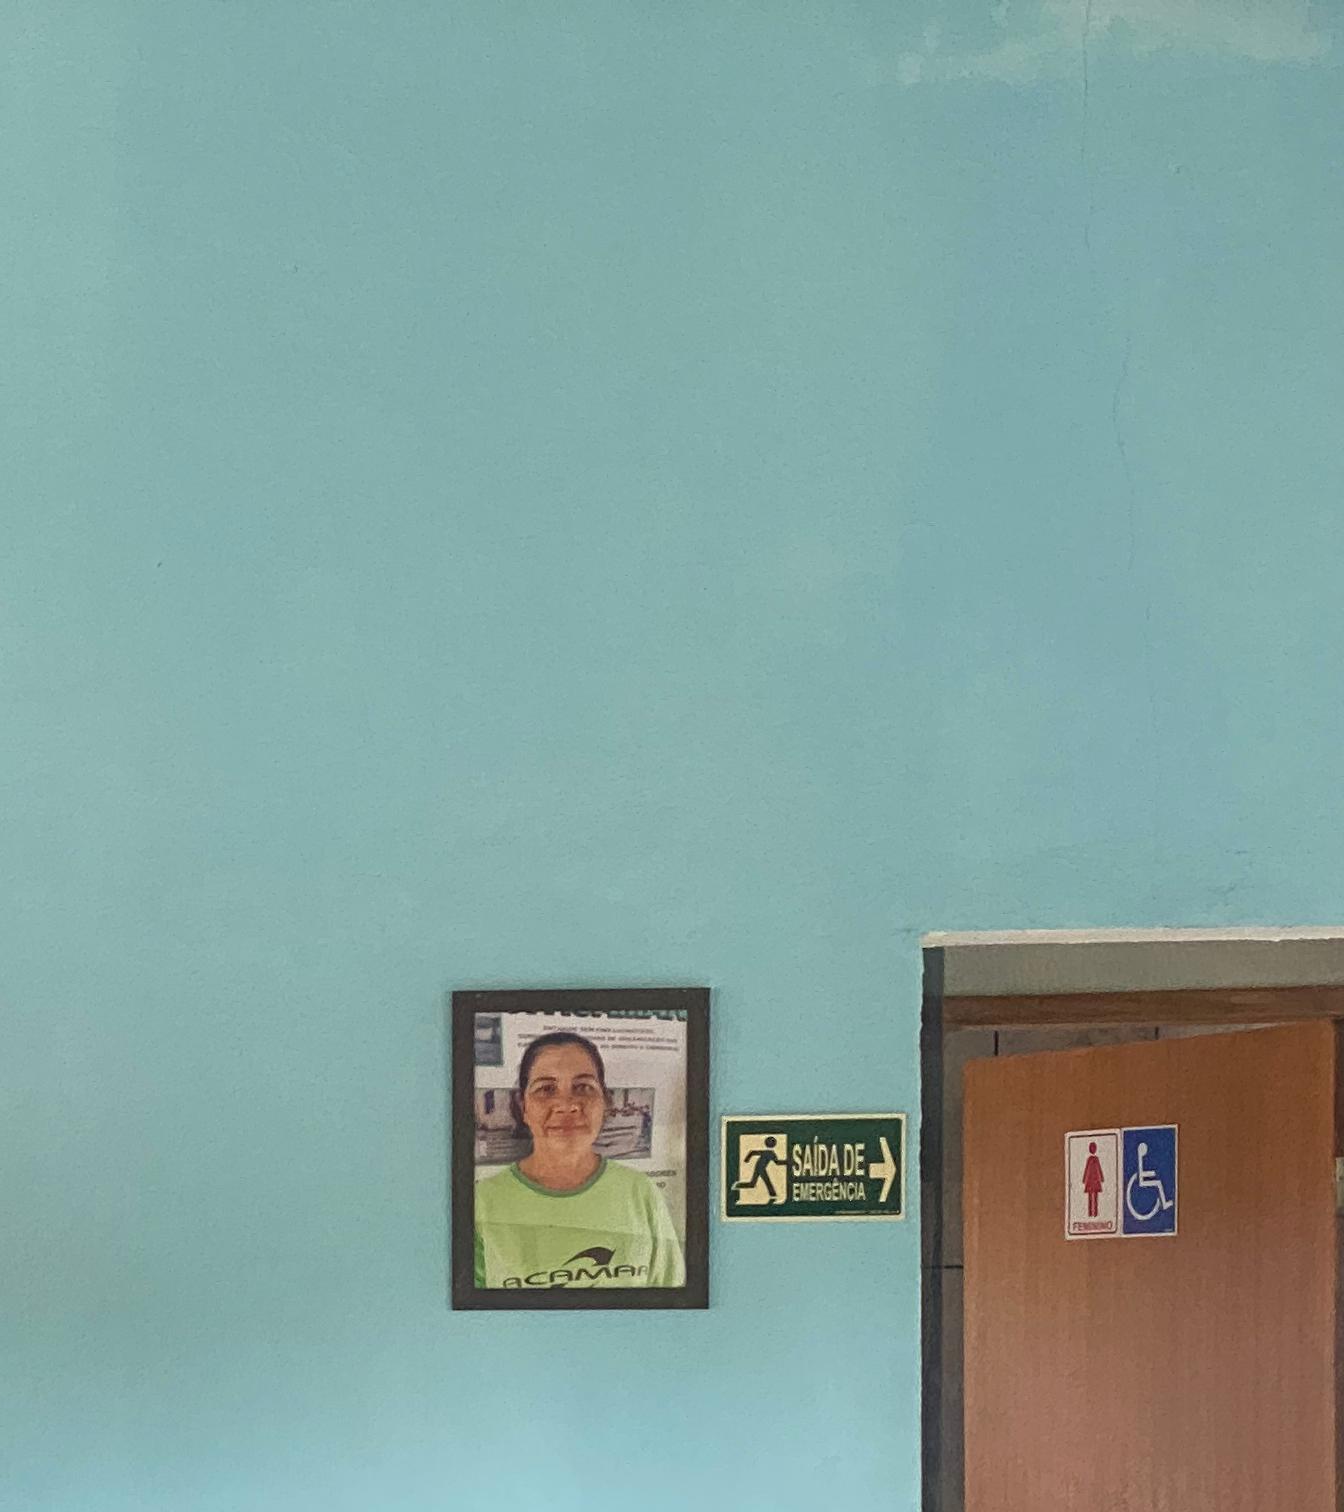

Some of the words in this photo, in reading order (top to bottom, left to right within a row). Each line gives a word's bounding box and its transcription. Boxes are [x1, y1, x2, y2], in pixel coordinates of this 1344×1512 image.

[792, 1135, 841, 1177] SAÍDA
[843, 1143, 866, 1176] DE
[792, 1177, 867, 1202] EMERGÊNCIA
